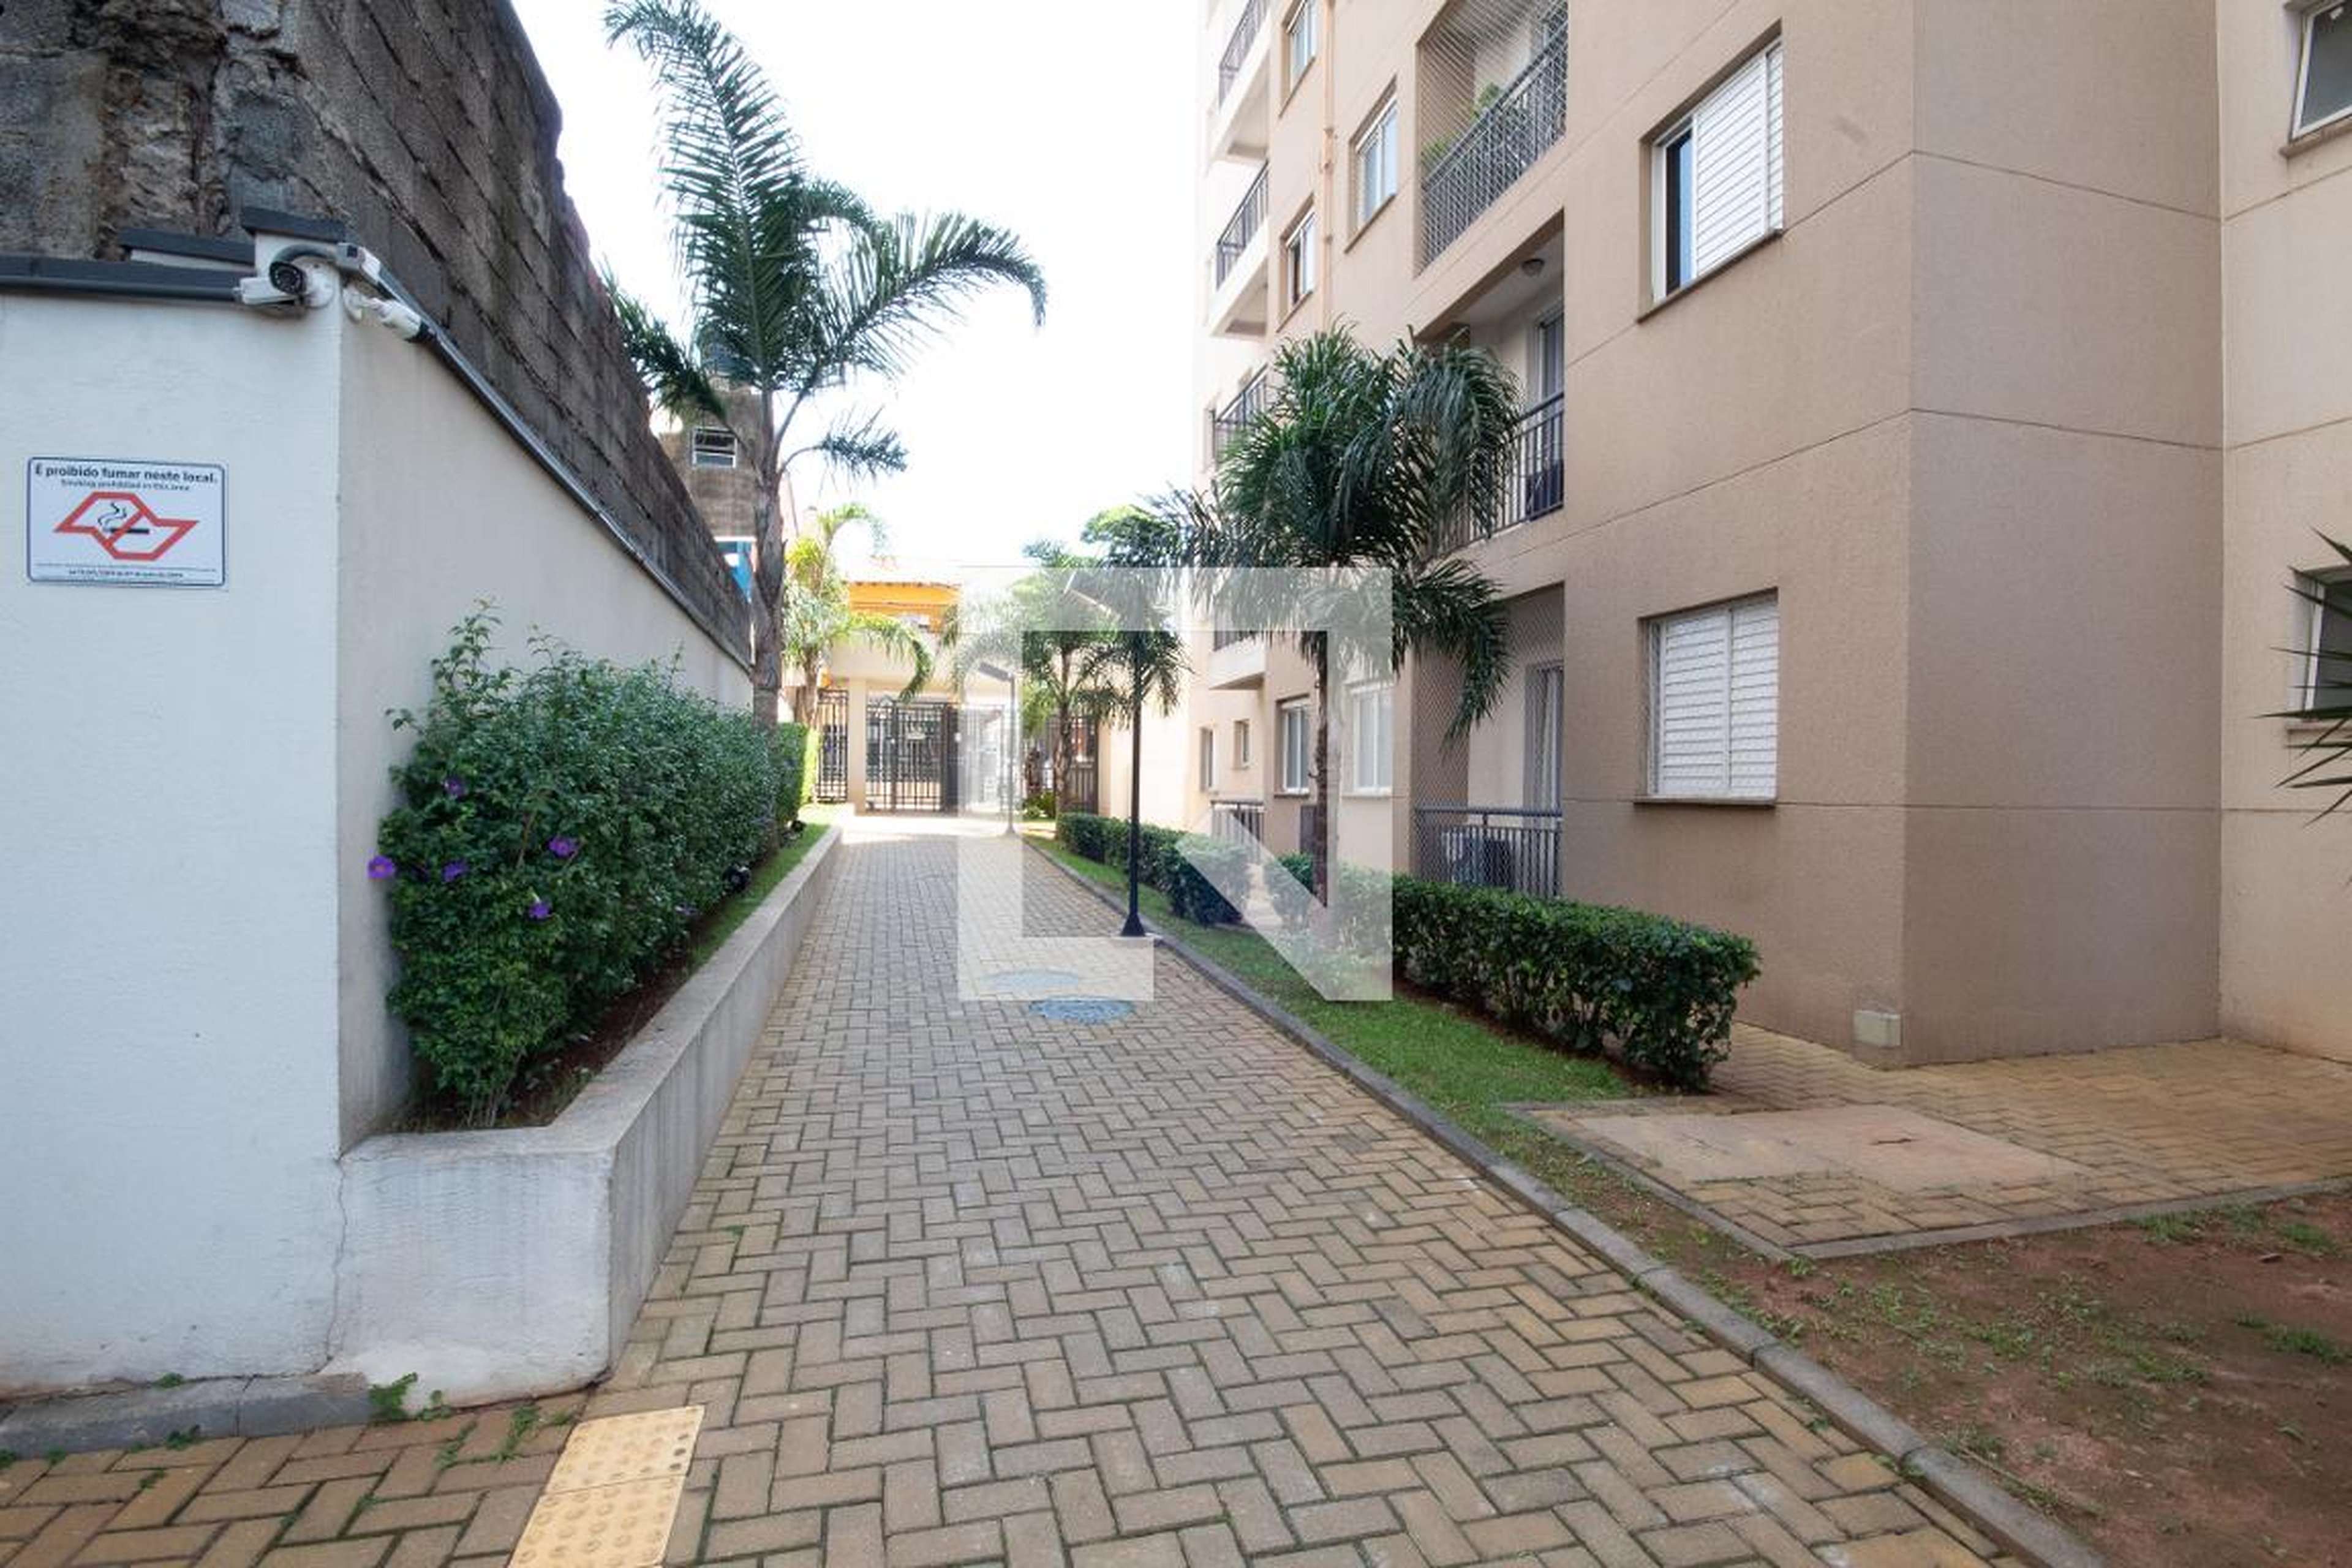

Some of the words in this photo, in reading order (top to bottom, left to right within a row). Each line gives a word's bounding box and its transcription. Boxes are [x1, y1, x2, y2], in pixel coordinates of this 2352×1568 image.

[46, 465, 99, 478] proibido
[102, 467, 141, 479] fumar
[145, 470, 181, 481] neste
